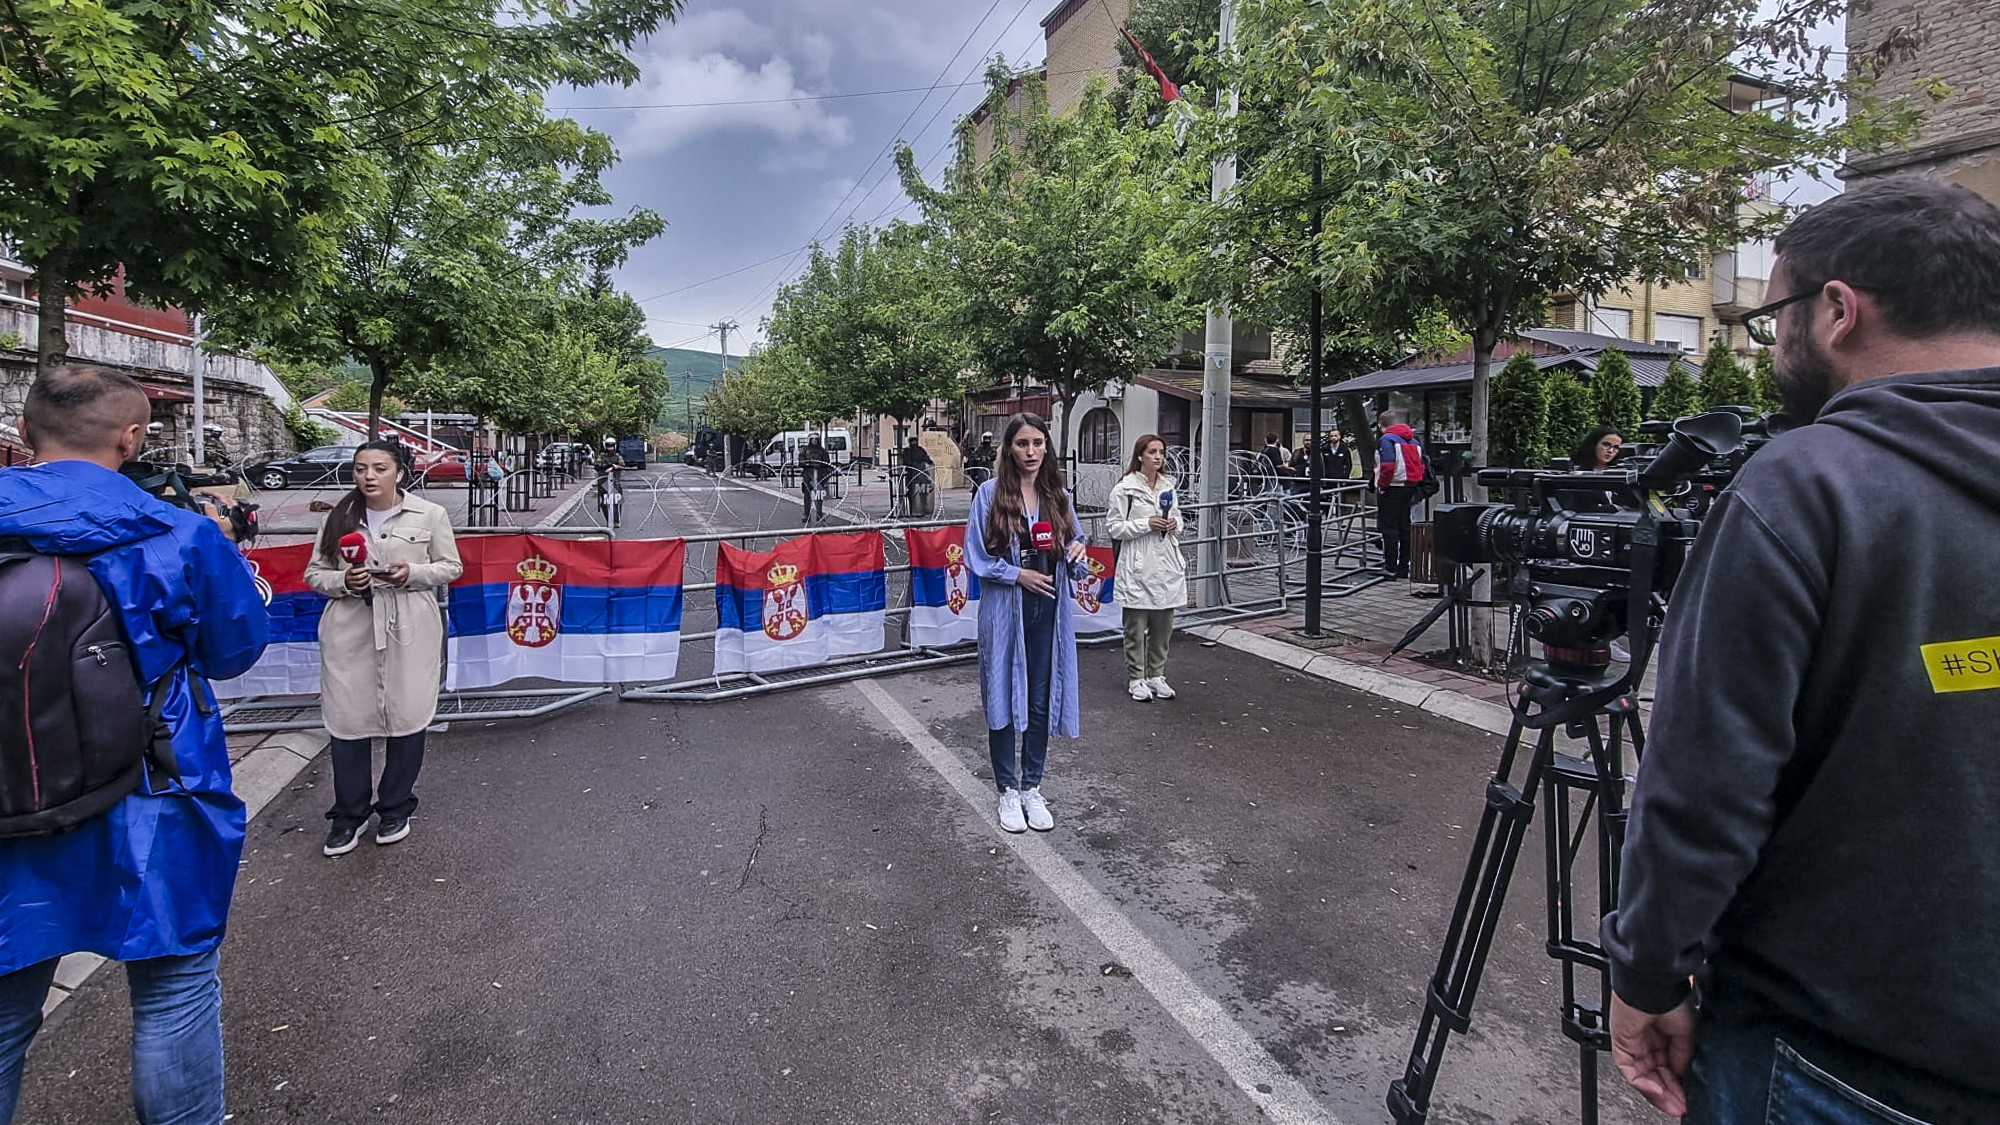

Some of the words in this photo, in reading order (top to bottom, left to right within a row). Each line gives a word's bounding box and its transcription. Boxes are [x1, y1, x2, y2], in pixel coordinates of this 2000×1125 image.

[914, 483, 932, 494] MP
[603, 493, 622, 505] MP
[810, 490, 827, 500] MP
[1579, 543, 1591, 551] JO
[1507, 603, 1521, 663] Panasonic
